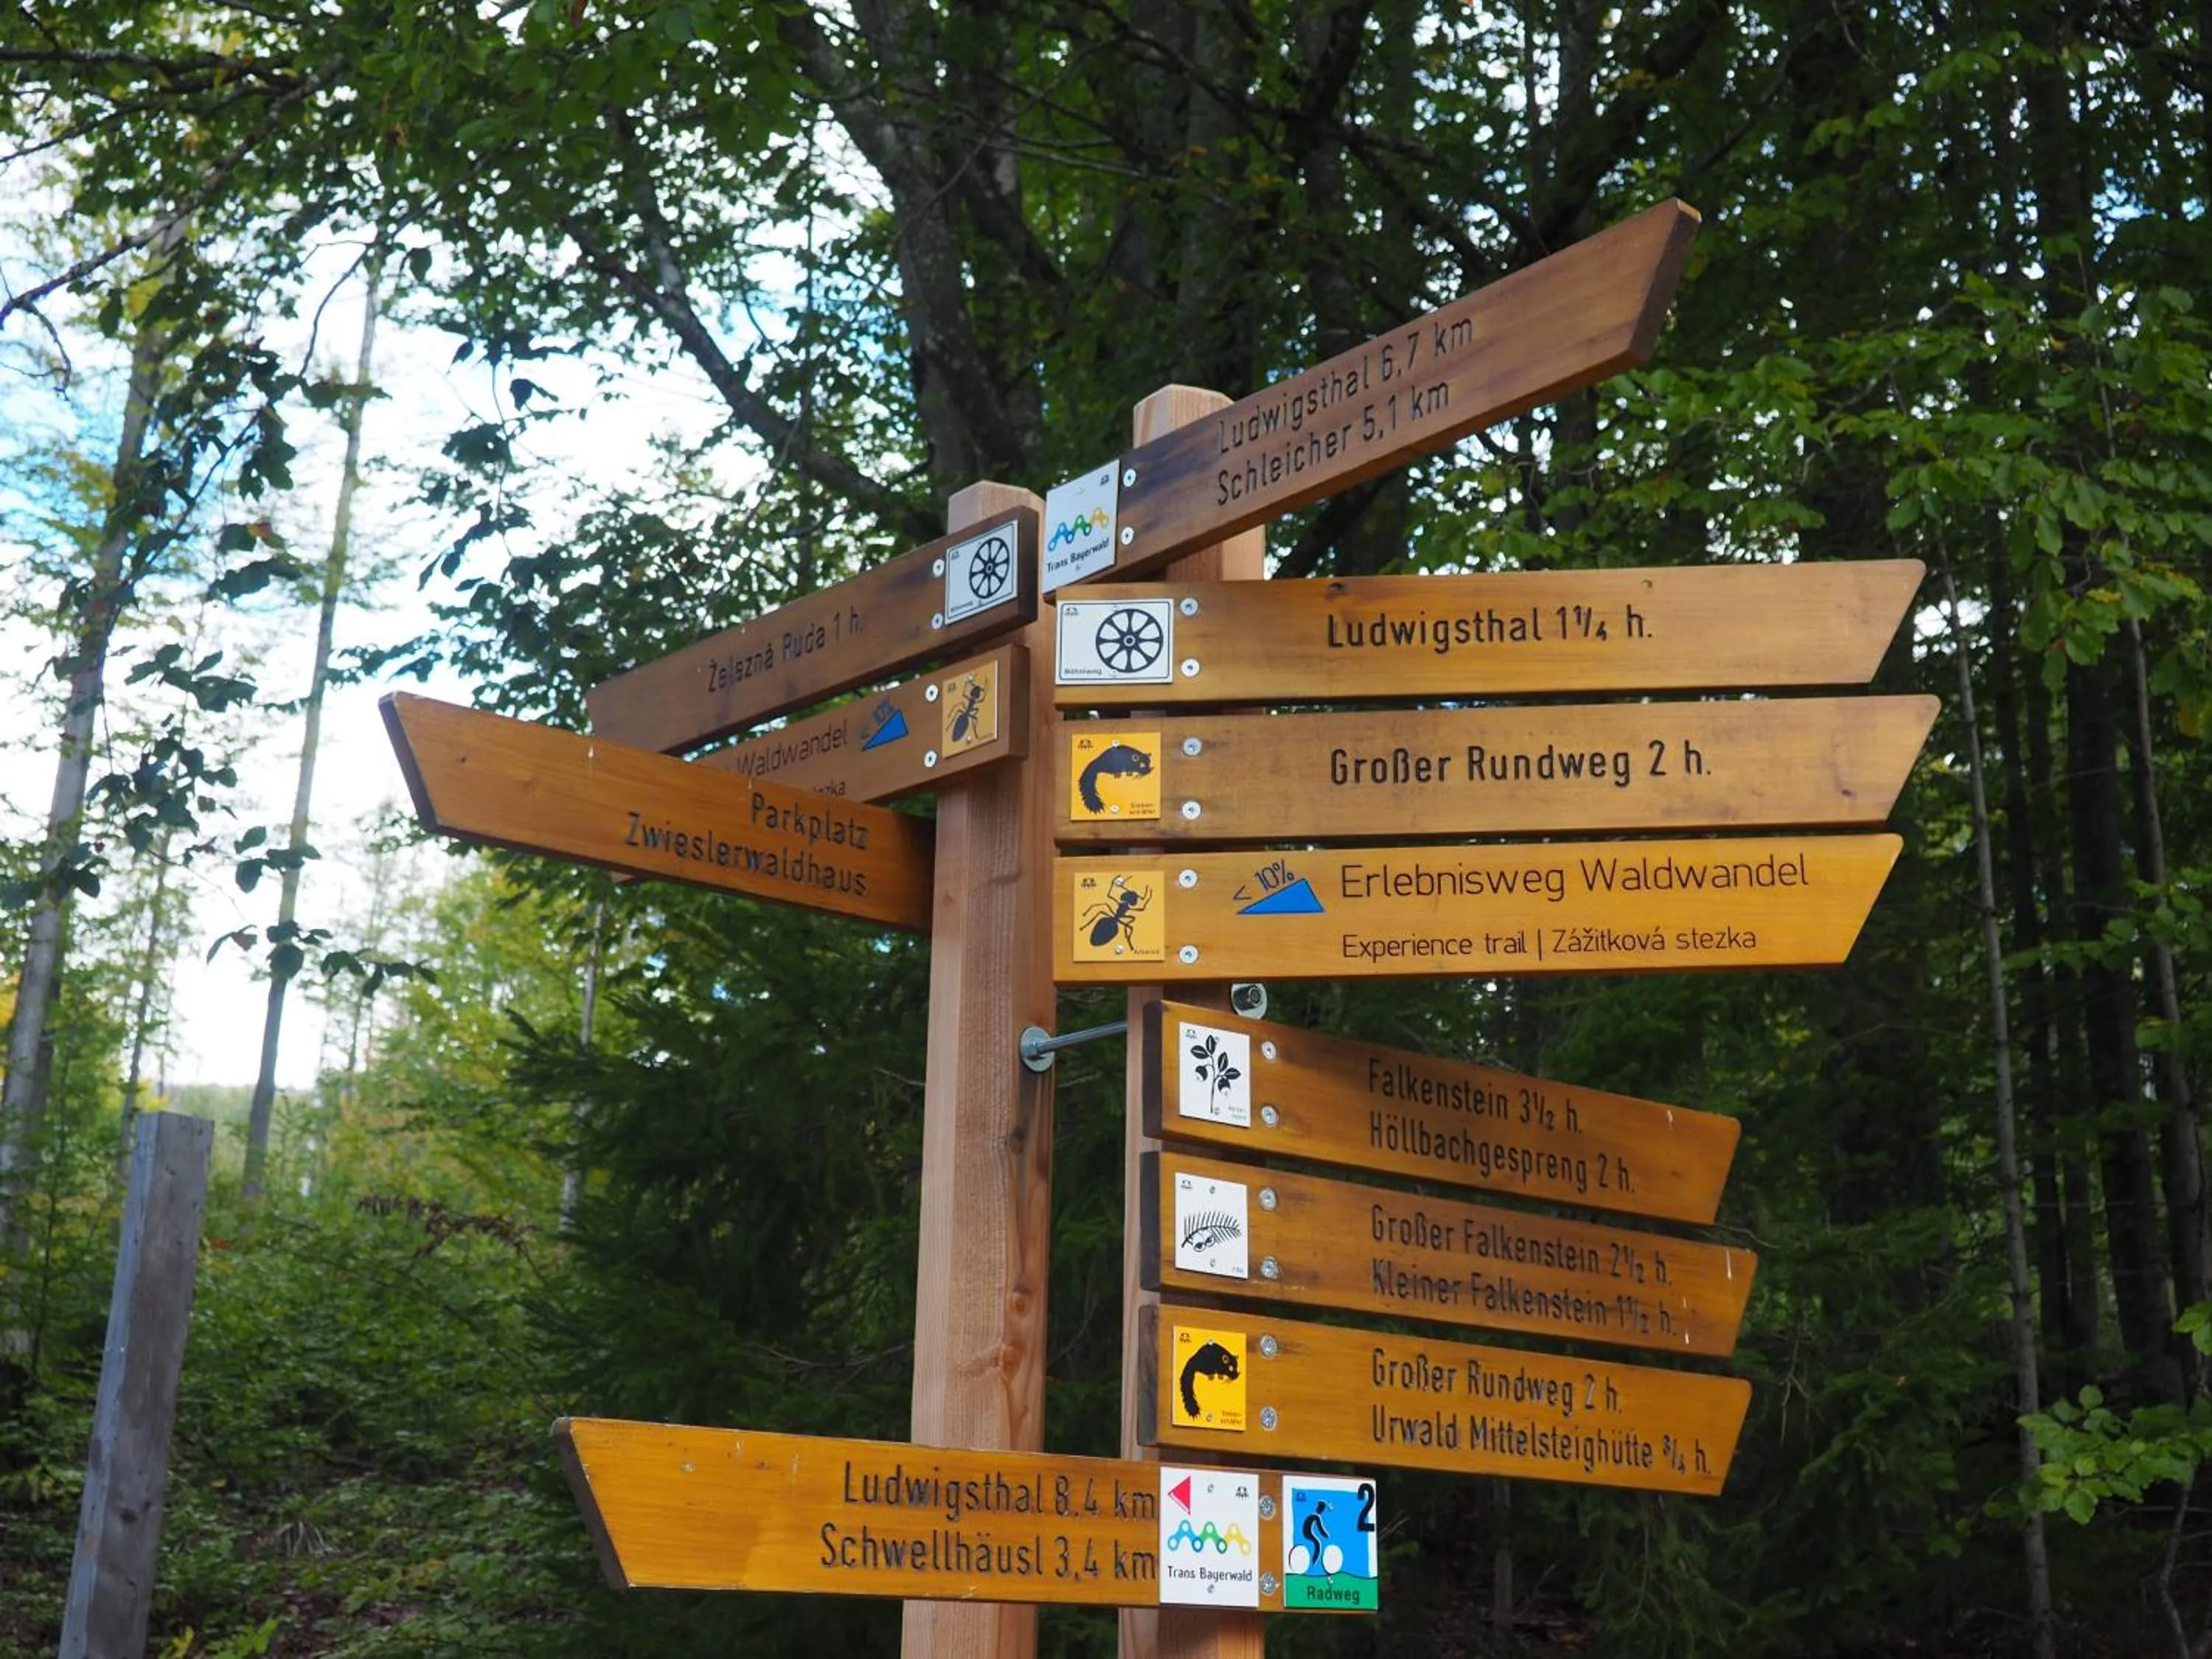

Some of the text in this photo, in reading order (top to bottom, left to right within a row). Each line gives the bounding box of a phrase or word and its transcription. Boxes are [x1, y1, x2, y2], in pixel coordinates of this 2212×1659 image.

[1219, 317, 1472, 455] Ludwigsthal 6,7 km
[1217, 380, 1450, 506] Schleicher 5,1 km
[1047, 558, 1068, 573] Trans
[782, 622, 826, 661] Ruda
[833, 611, 841, 642] 1
[1327, 607, 1543, 655] Ludwigsthal
[1626, 603, 1653, 638] h.
[738, 719, 849, 776] Waldwandel
[1330, 739, 1711, 787] Großer Rundweg 2 h.
[751, 792, 871, 850] Parkplatz
[624, 810, 869, 897] Zwieslerwaldhaus
[1255, 859, 1295, 891] 10%
[1340, 853, 1809, 902] Erlebnisweg Waldwandel
[1341, 932, 1473, 964] Experience
[1484, 929, 1527, 955] trail
[1552, 925, 1665, 953] Zážitková
[1675, 925, 1757, 950] stezka
[1368, 1056, 1509, 1120] Falkenstein
[1566, 1098, 1583, 1134] h.
[1369, 1110, 1635, 1194] Höllbachgespreng 2 h.
[1371, 1204, 1455, 1251] Großer
[1464, 1219, 1600, 1275] Falkenstein
[1655, 1250, 1672, 1286] h.
[1371, 1258, 1461, 1305] Kleiner
[1471, 1273, 1607, 1326] Falkenstein
[1658, 1300, 1677, 1336] h.
[1372, 1347, 1622, 1416] Großer Rundweg 2 h.
[1371, 1404, 1458, 1450] Urwald
[1470, 1414, 1652, 1472] Mittelsteighütte
[1695, 1438, 1711, 1475] h.
[844, 1461, 1043, 1521] Ludwigsthal
[1113, 1478, 1155, 1519] km
[1357, 1483, 1376, 1532] 2
[820, 1522, 1156, 1582] Schwellhäusl 3,4 km
[1167, 1565, 1253, 1582] Trans Bayerwald
[1306, 1585, 1360, 1604] Radweg
